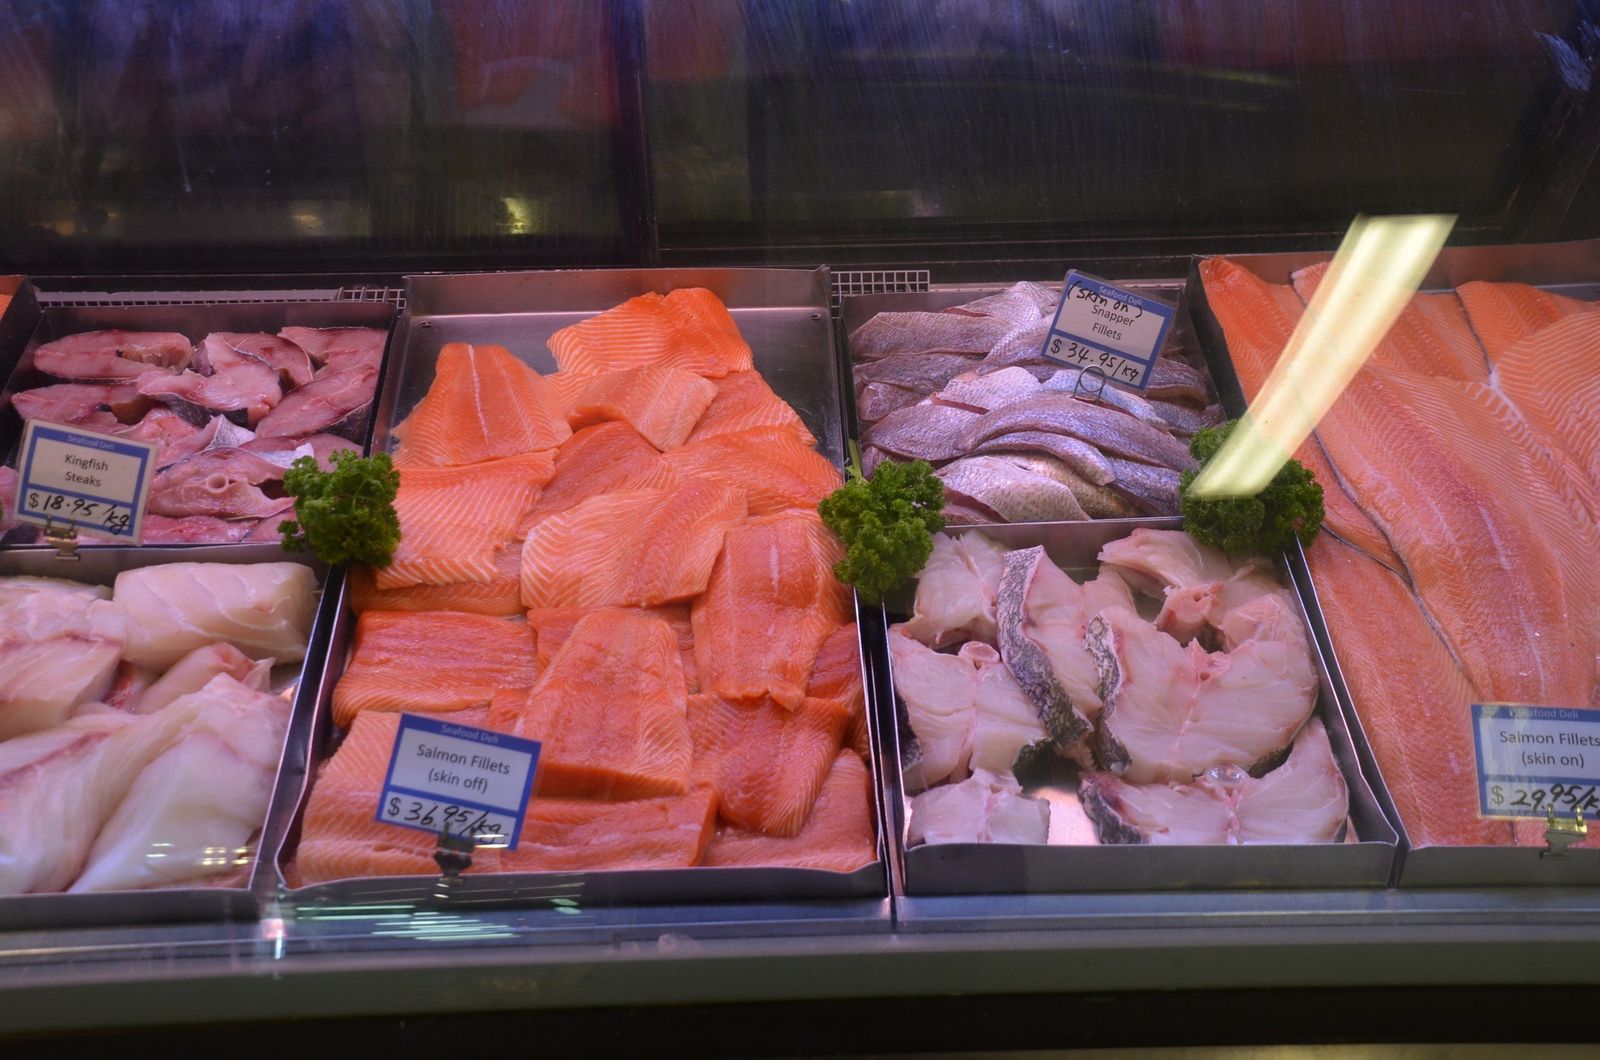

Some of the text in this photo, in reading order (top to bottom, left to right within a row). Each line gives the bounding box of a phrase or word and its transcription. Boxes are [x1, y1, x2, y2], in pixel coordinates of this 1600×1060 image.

[1099, 286, 1128, 302] Seafood
[1091, 304, 1135, 327] Snapper
[1091, 322, 1122, 341] Fillets
[68, 434, 115, 450] Seafood Deli
[65, 454, 109, 472] Kingfish
[65, 471, 101, 487] Steaks
[1516, 708, 1579, 719] Safood Deli
[441, 724, 500, 744] Seafood Deli
[1500, 731, 1600, 746] Salmon Fillets
[416, 744, 511, 775] Salmon Fillets
[1521, 751, 1585, 769] (skin on)
[428, 768, 488, 794] (skin off)
